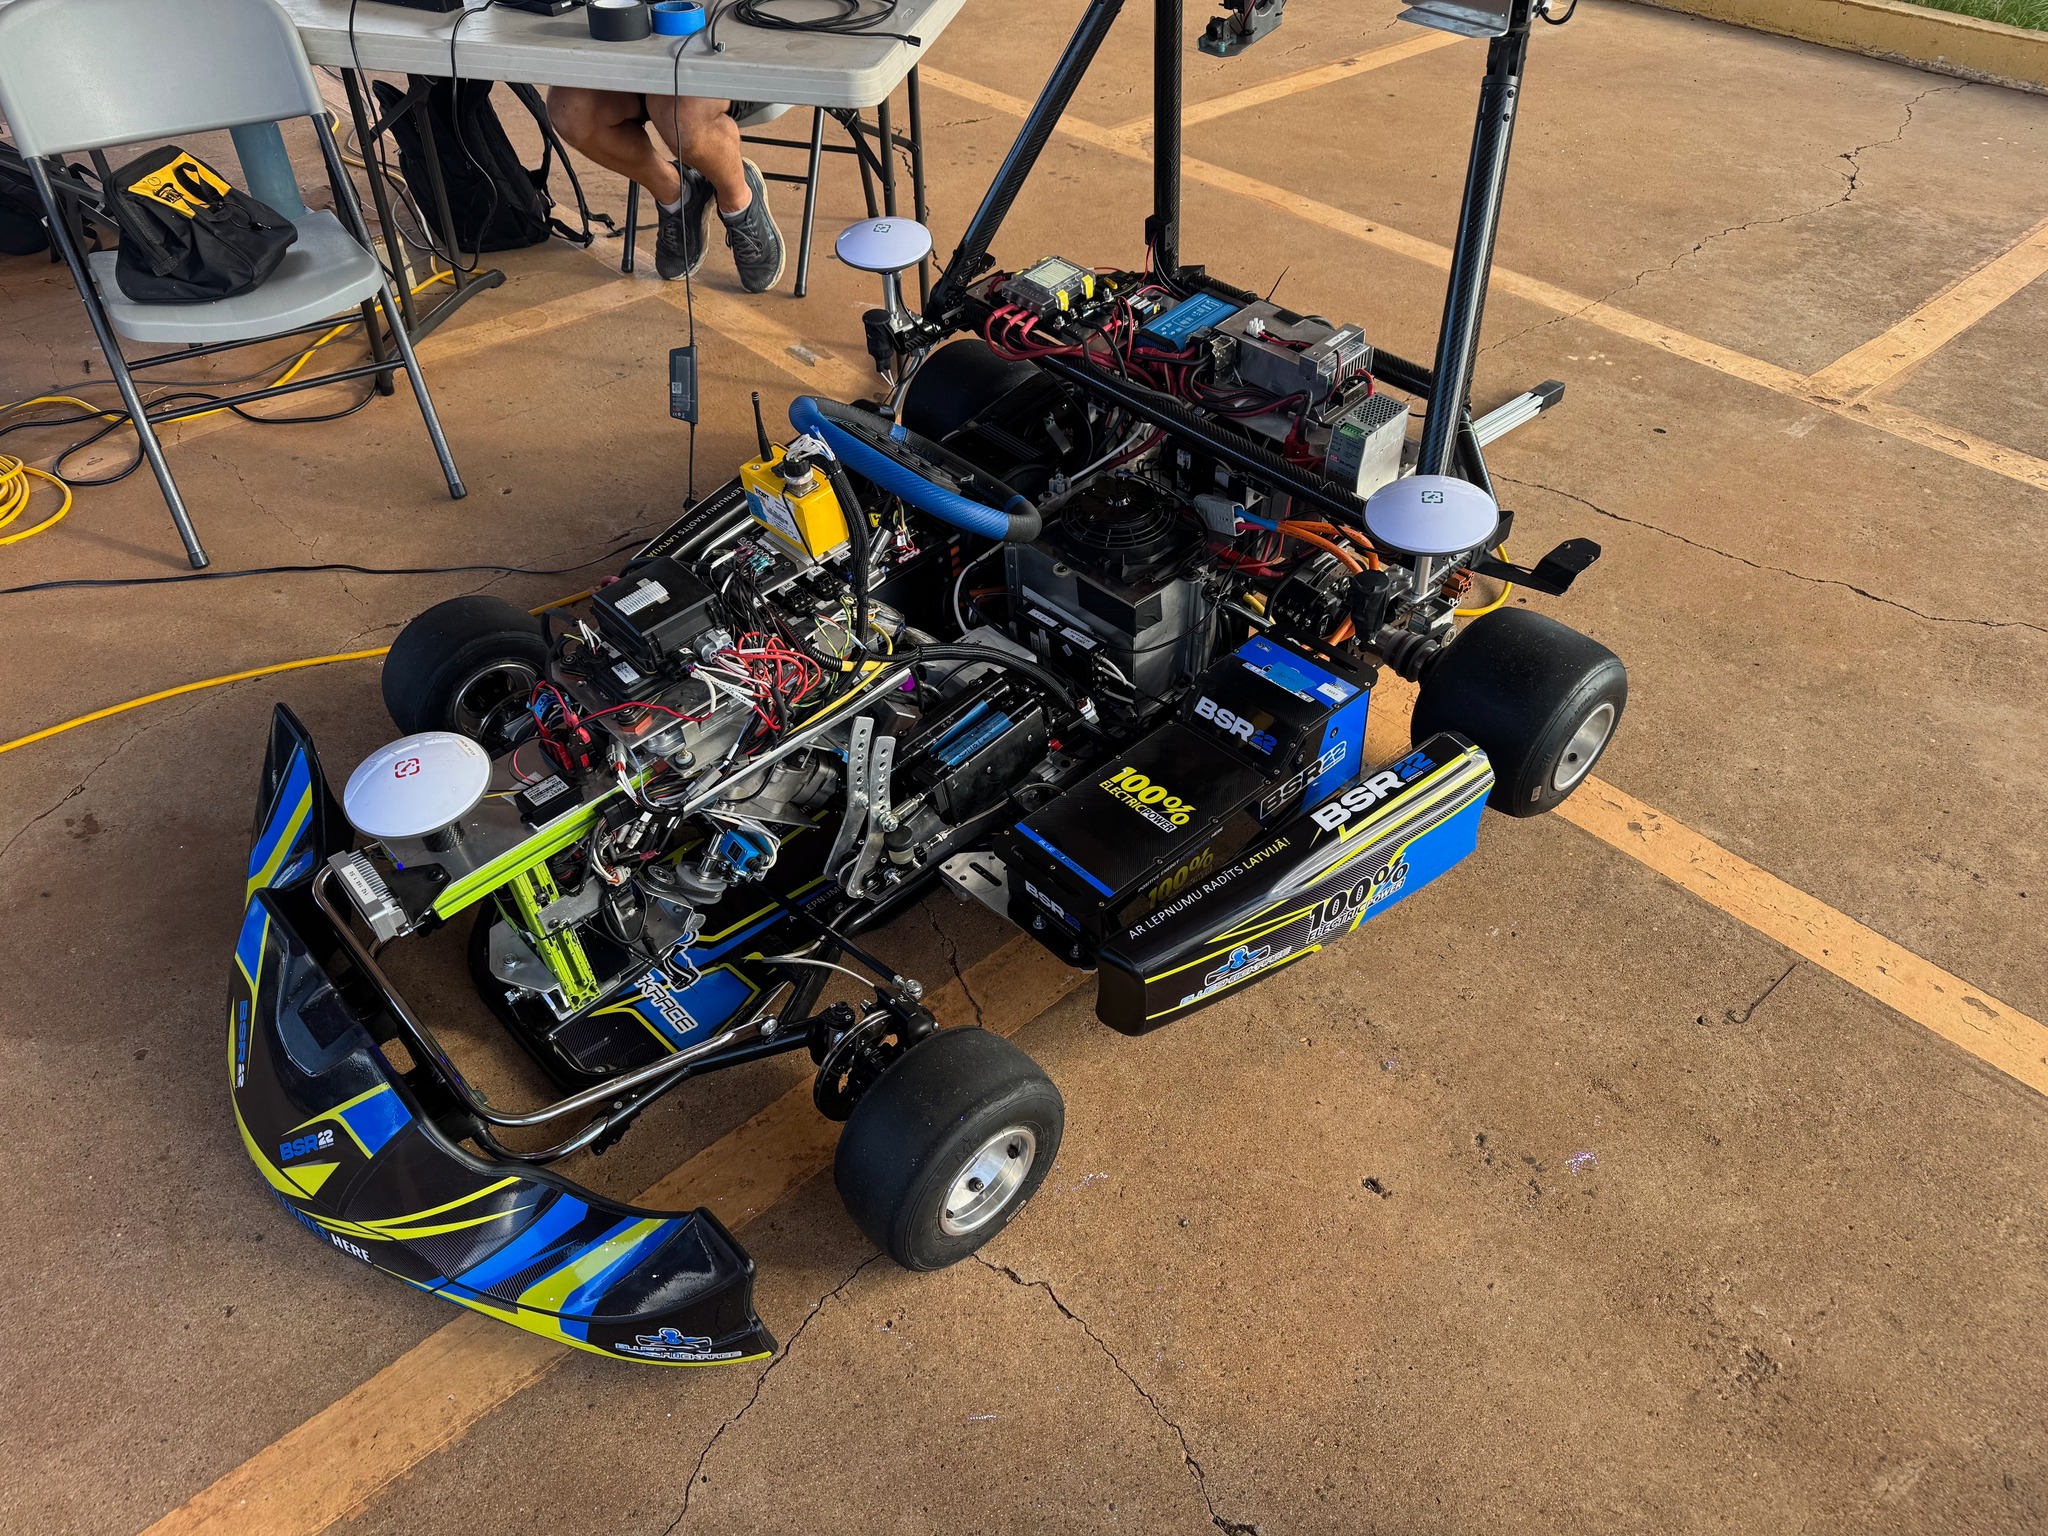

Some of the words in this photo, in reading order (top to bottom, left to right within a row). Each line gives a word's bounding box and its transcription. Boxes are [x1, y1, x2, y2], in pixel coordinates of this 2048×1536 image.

[1194, 696, 1277, 754] BSR22
[1110, 766, 1196, 825] 100%
[1260, 741, 1347, 819] BSR22
[1310, 752, 1433, 832] BSR22
[1129, 924, 1147, 940] AR
[1145, 888, 1202, 929] LEPNUMU
[1204, 865, 1244, 895] RADĪTS
[1243, 837, 1291, 870] LATVIJĀ!
[1148, 847, 1214, 909] 100%
[1308, 853, 1409, 931] 100%
[279, 1129, 334, 1161] BSR22
[330, 1232, 372, 1263] HERE
